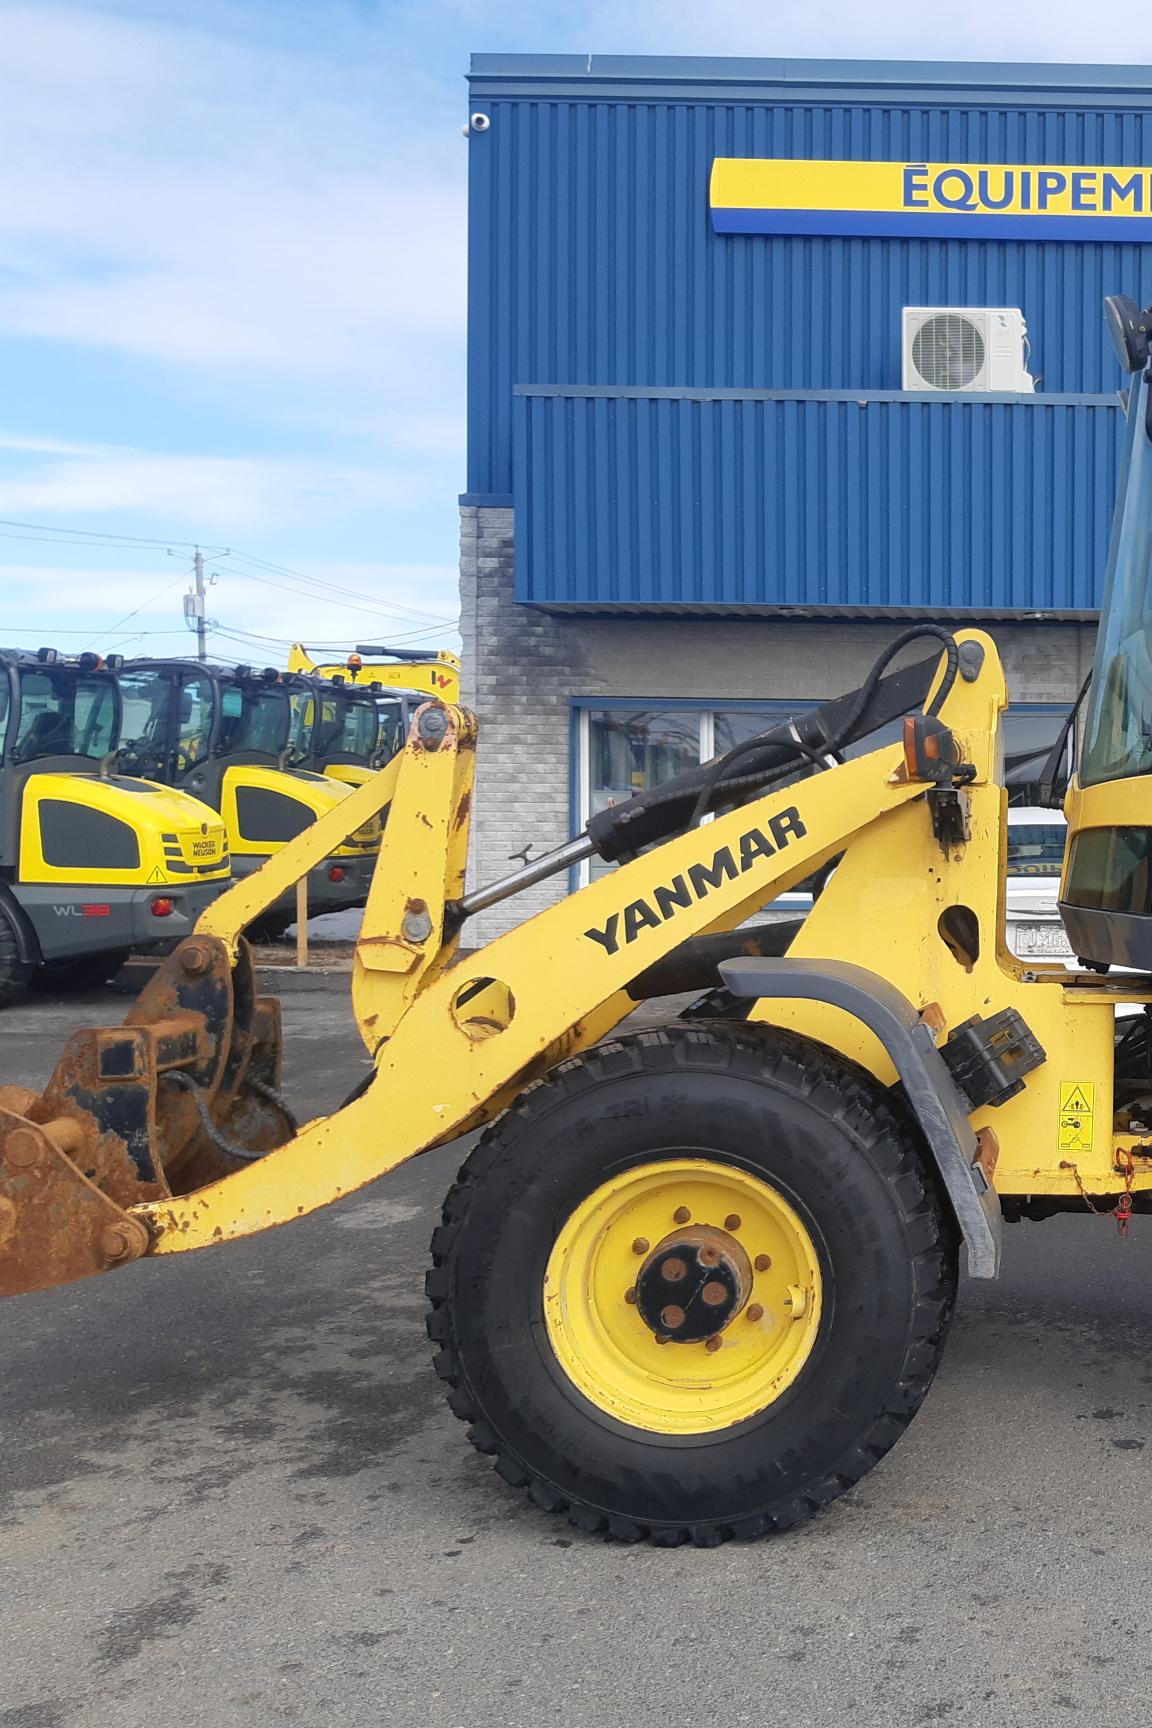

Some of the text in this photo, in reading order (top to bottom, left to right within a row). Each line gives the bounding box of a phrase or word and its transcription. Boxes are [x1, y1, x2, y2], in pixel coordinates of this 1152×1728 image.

[192, 840, 216, 849] WACKER
[192, 848, 217, 857] NEUSON
[583, 806, 808, 956] YANMAR
[53, 904, 111, 917] WL38
